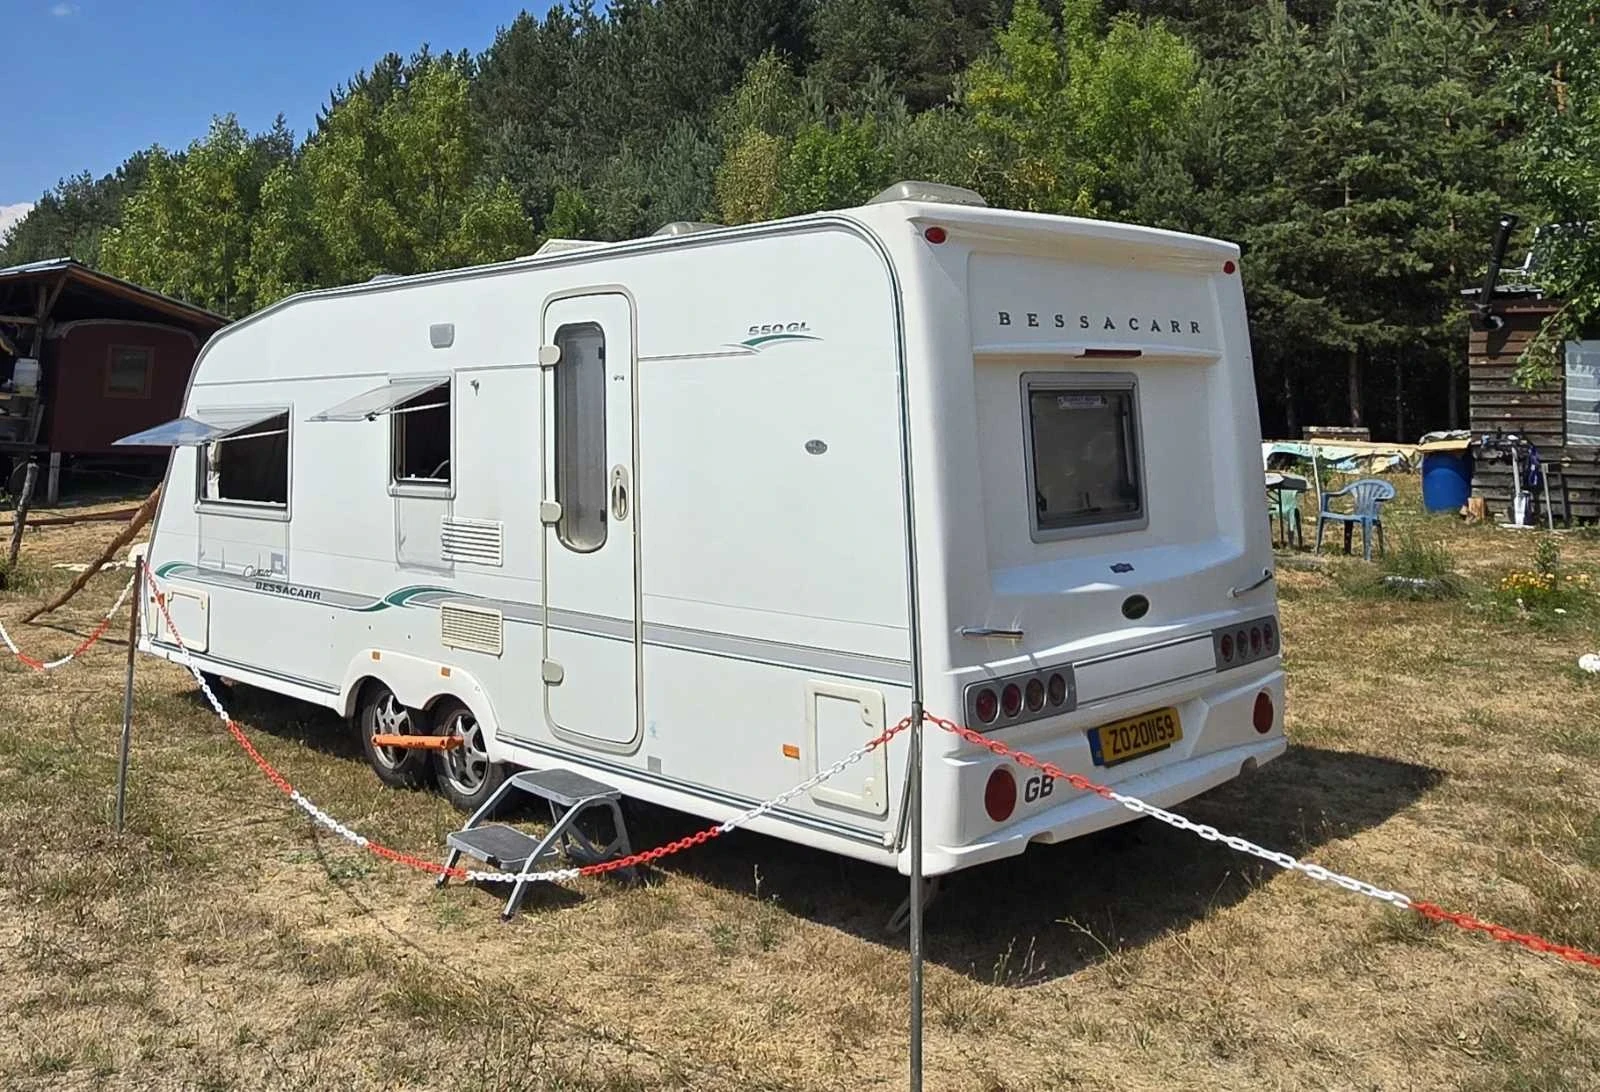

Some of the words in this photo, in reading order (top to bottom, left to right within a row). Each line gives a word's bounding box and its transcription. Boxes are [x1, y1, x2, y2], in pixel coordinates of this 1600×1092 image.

[998, 311, 1201, 334] BESSACARR
[255, 581, 321, 601] BESSACARR
[1024, 773, 1055, 803] GB
